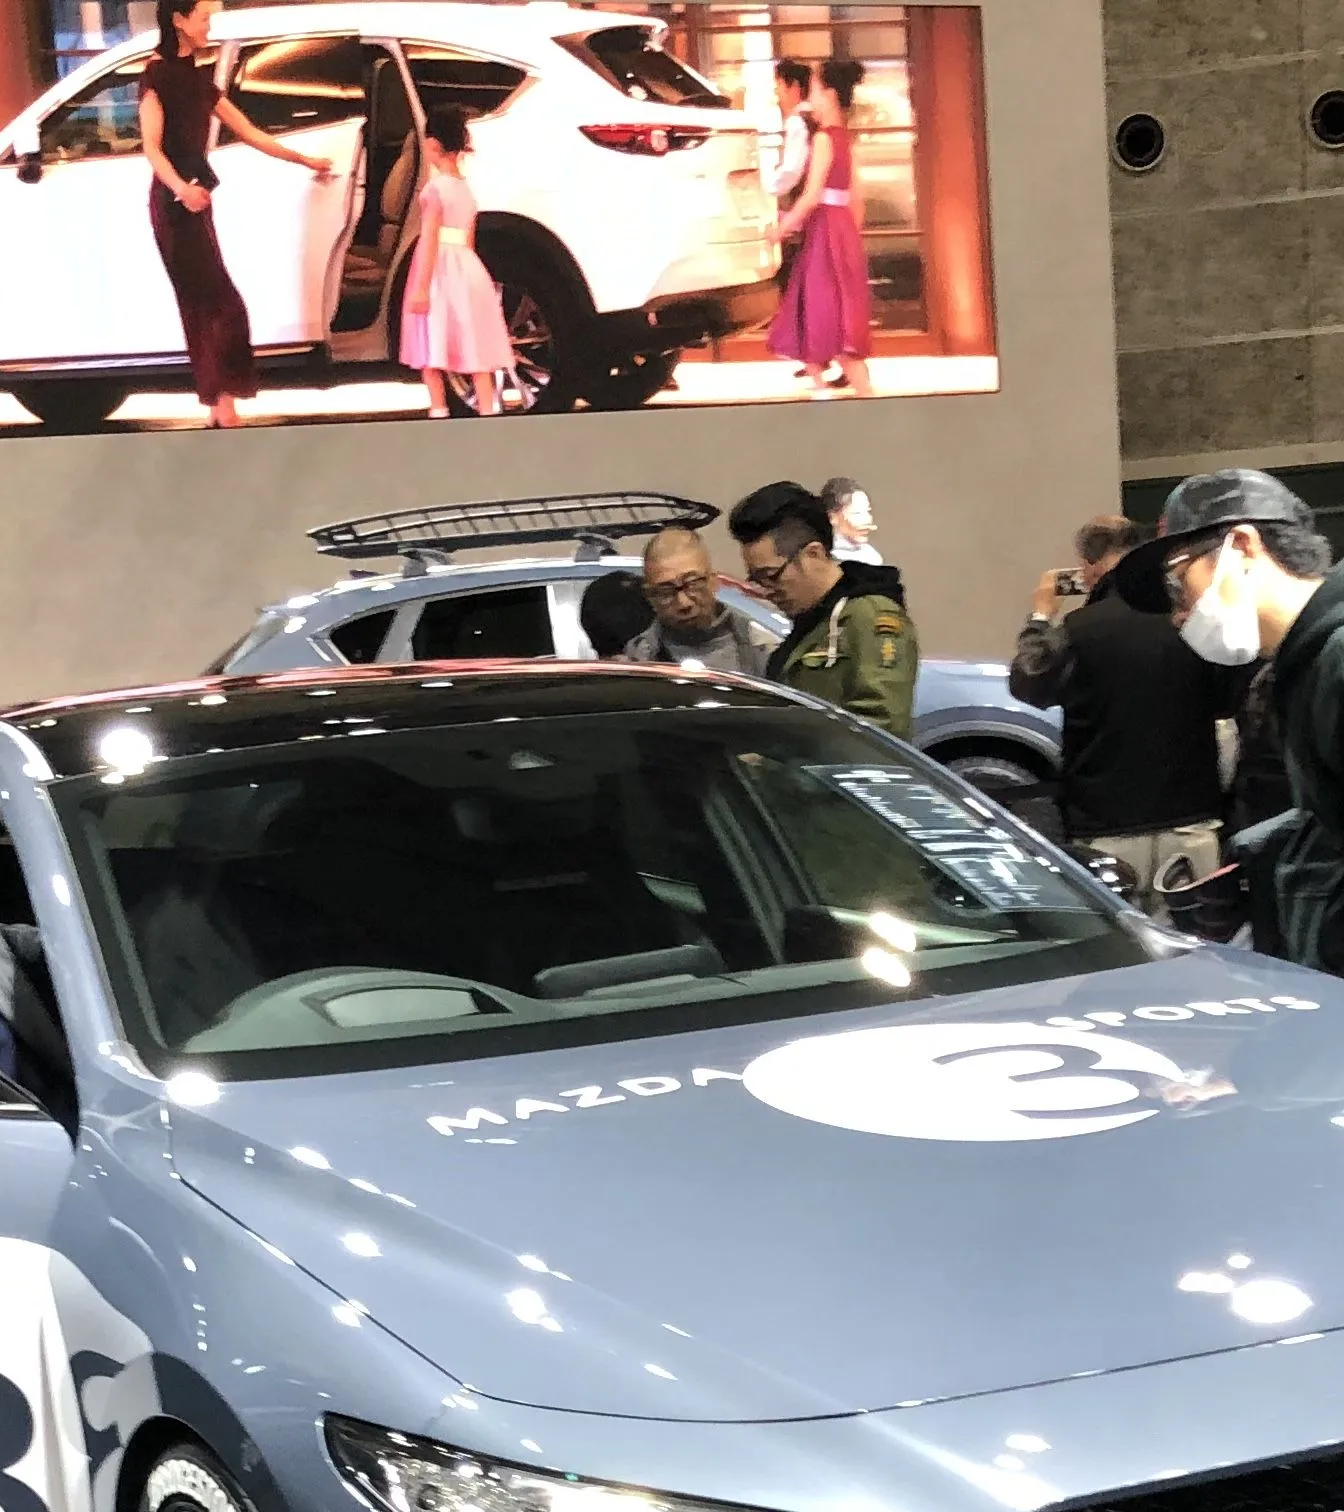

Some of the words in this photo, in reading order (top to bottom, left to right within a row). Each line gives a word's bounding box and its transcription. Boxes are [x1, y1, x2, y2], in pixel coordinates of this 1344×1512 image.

[1044, 995, 1322, 1032] SPORTS
[424, 1067, 744, 1136] MAZDA
[931, 1042, 1178, 1121] 3
